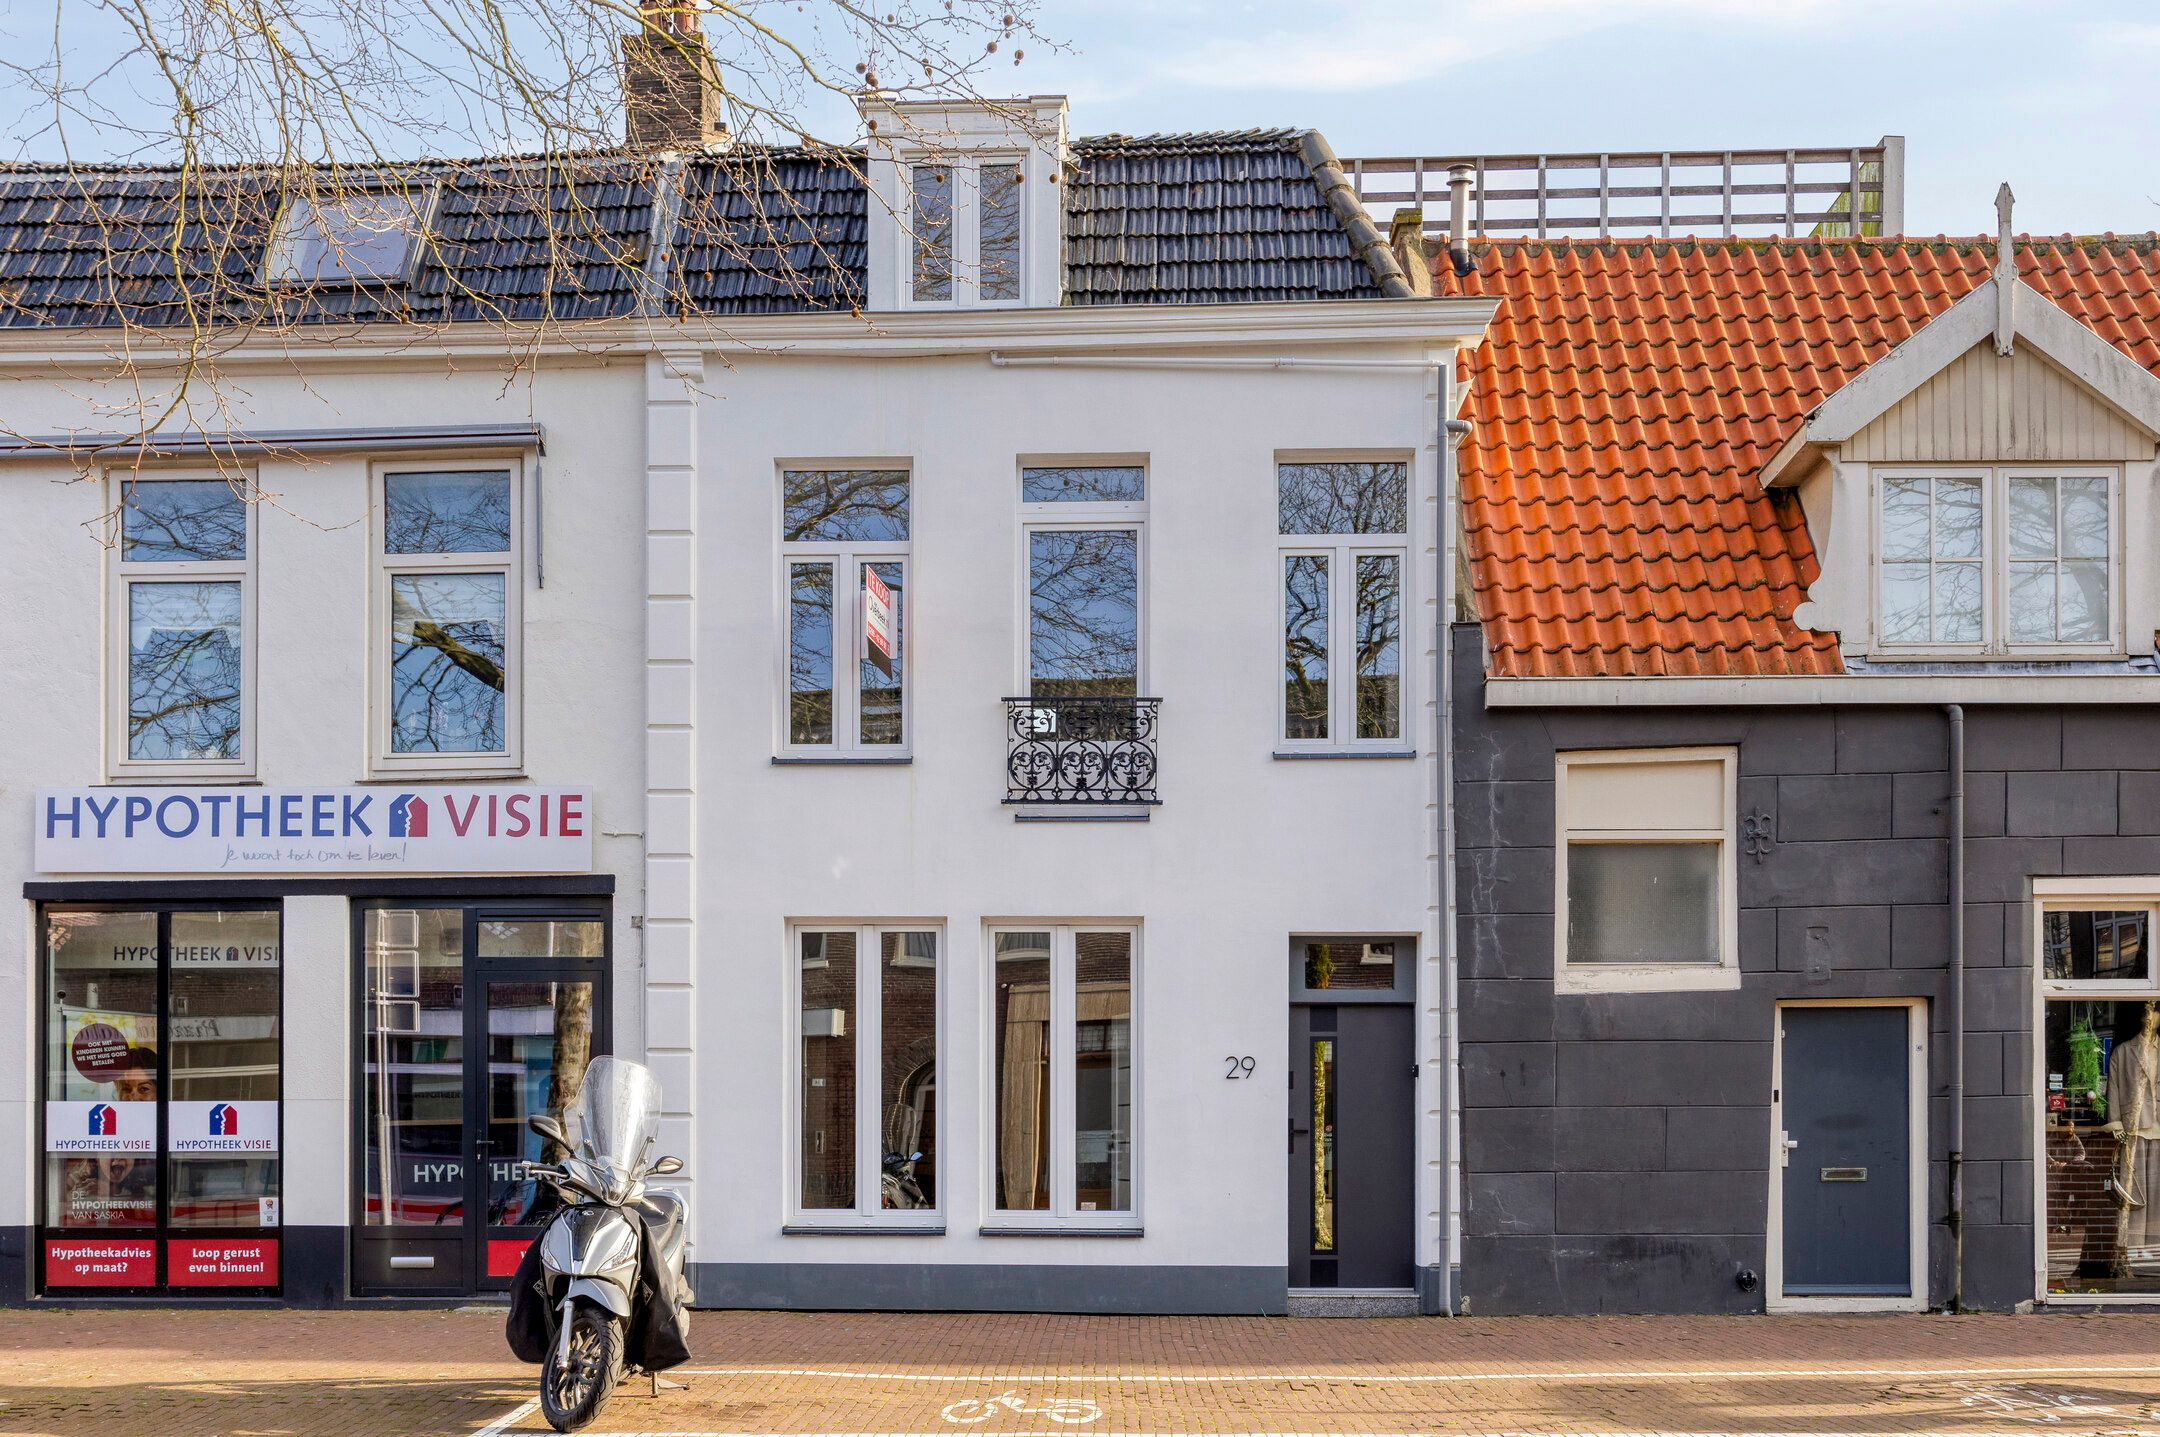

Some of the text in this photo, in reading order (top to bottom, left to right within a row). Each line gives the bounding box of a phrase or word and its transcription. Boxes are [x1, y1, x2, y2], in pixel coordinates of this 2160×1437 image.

[46, 793, 583, 839] HYPOTHEEK VISIE
[347, 850, 362, 861] te
[368, 842, 407, 862] leven!
[1225, 1055, 1256, 1080] 29
[55, 1139, 151, 1150] HYPOTHEEK VISIE
[176, 1139, 272, 1150] HYPOTHEEK VISIE
[72, 1190, 85, 1200] DE
[72, 1200, 153, 1210] HYPOTHEEKVISIE
[72, 1210, 125, 1220] VAN SASKIA
[51, 1247, 152, 1260] Hypotheekadvies
[192, 1248, 261, 1260] Loop gerust
[74, 1262, 128, 1275] op maat?
[188, 1261, 264, 1273] even binnen!
